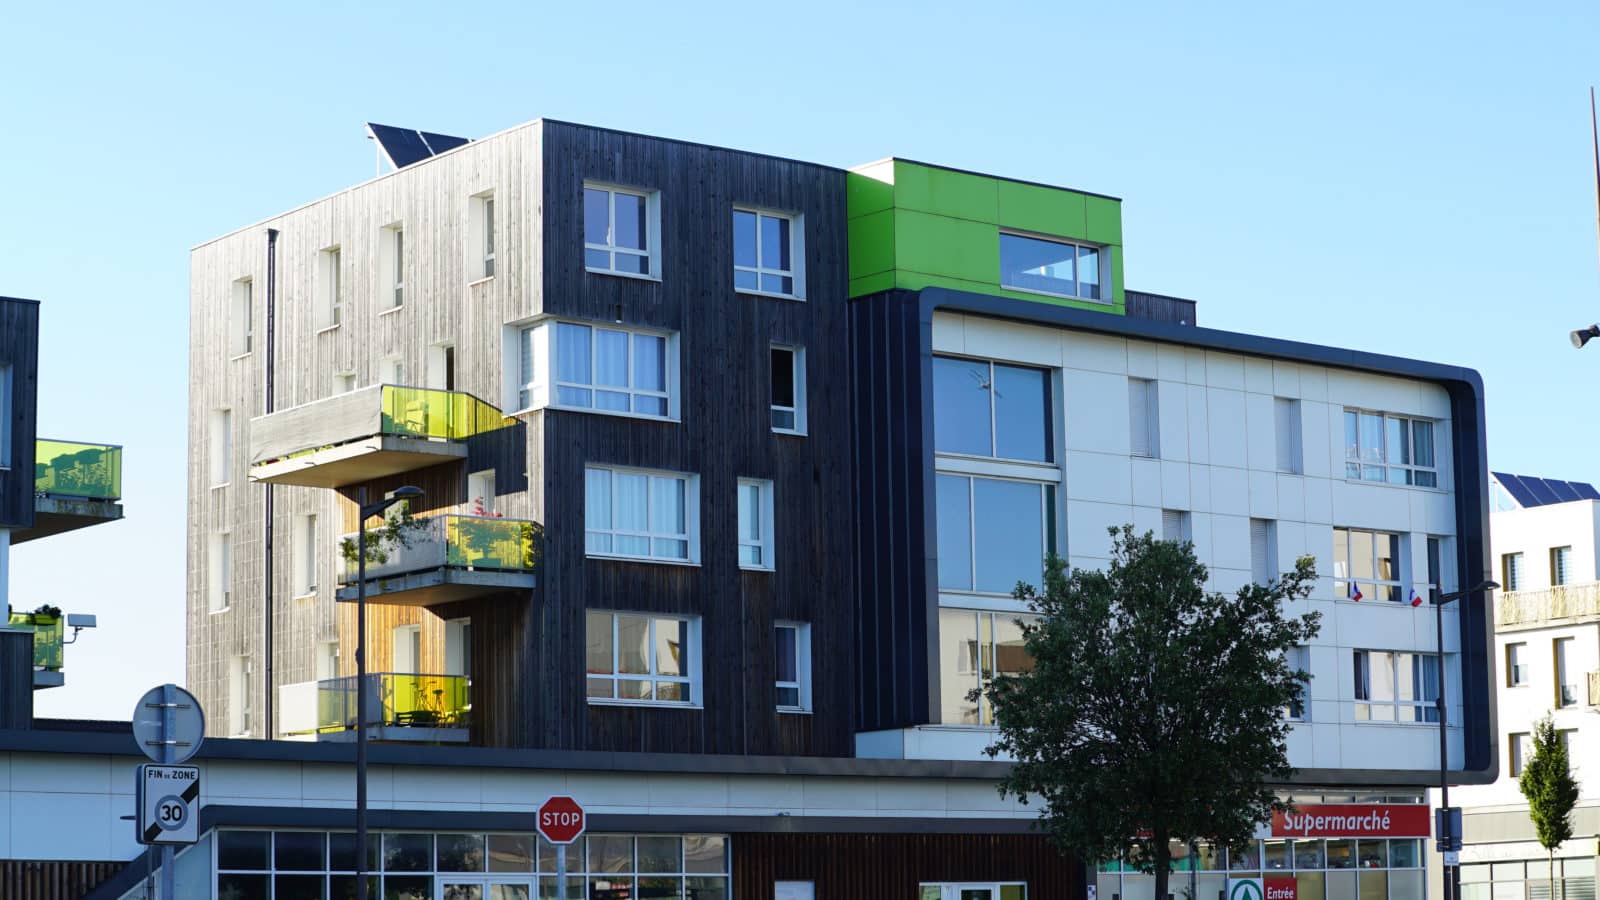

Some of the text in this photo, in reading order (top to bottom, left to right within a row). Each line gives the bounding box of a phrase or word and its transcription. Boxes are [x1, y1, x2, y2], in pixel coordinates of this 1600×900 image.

[148, 769, 163, 779] FIN
[172, 770, 196, 780] ZONE
[161, 804, 183, 822] 30
[542, 812, 580, 826] STOP
[1283, 810, 1391, 836] Supermarché
[1267, 887, 1294, 900] Entrée
